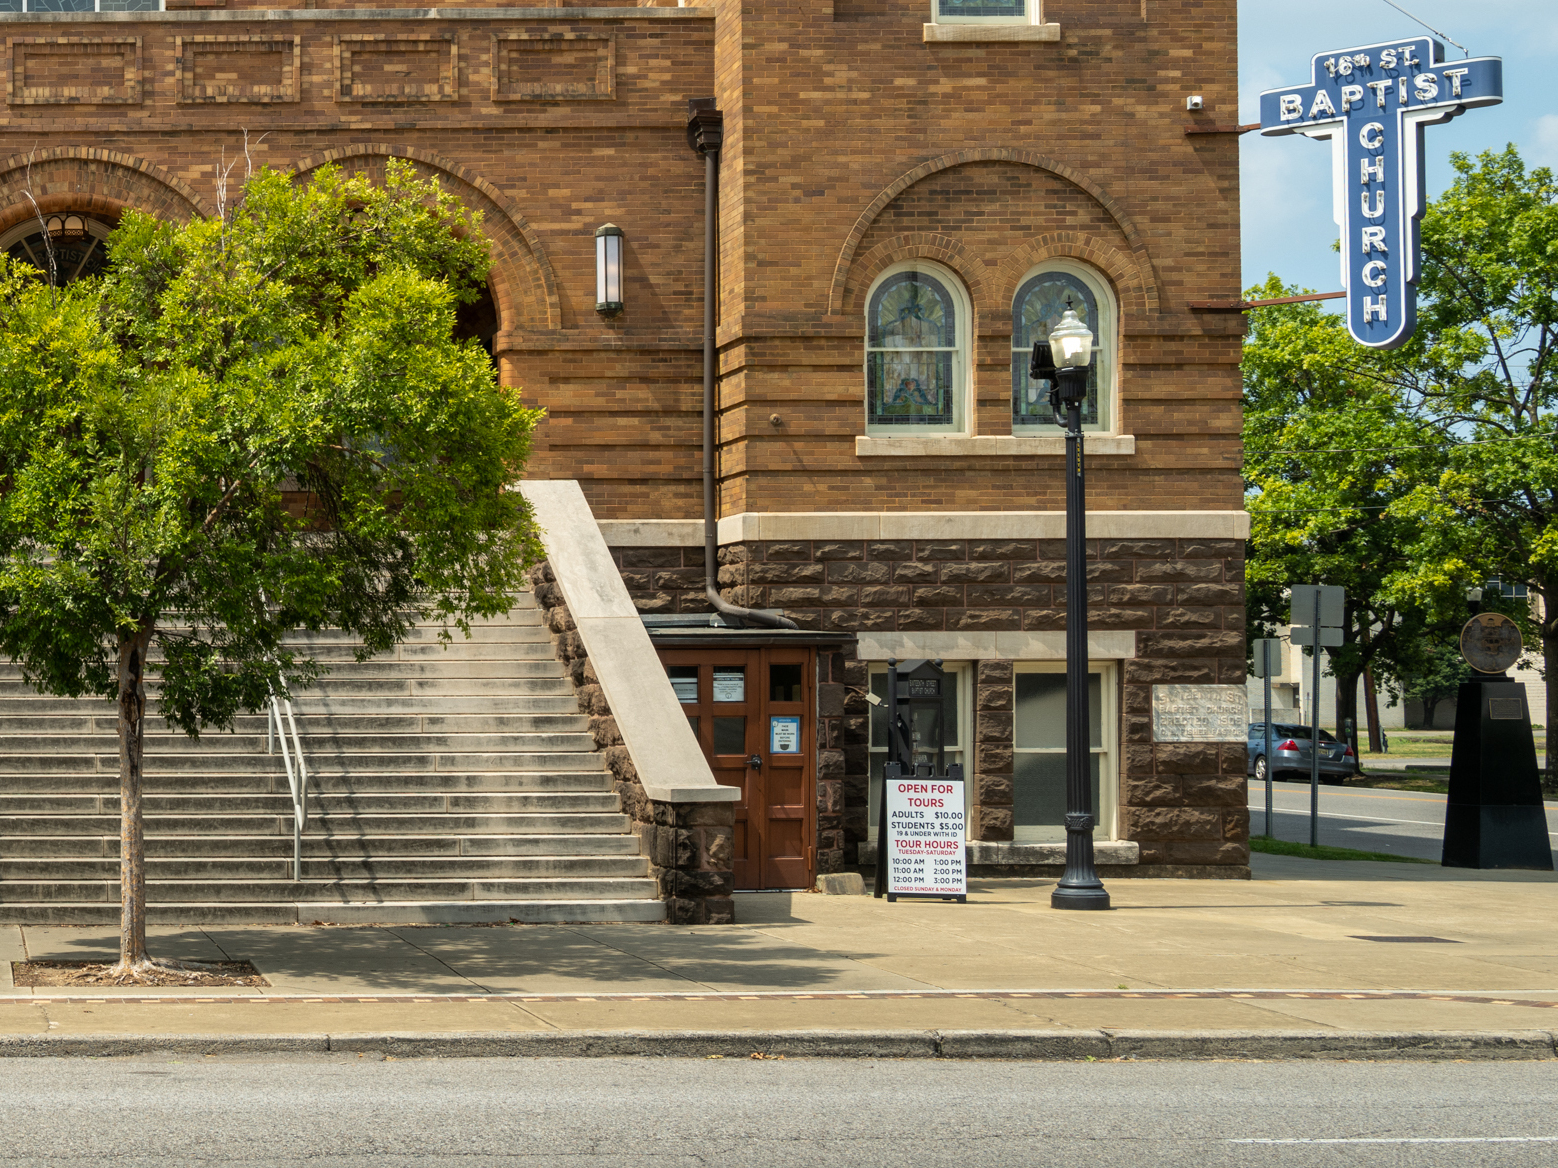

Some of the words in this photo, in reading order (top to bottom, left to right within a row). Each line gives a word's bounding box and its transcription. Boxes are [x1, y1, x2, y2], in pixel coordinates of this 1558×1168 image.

[1279, 67, 1469, 121] BAPTIST
[1359, 122, 1388, 323] CHURCH
[1159, 704, 1199, 713] BAPTIST
[1206, 705, 1242, 713] CHURCH
[1160, 715, 1209, 725] ERECTED
[897, 783, 928, 794] OPEN
[931, 784, 953, 794] FOR
[907, 797, 944, 808] TOURS
[891, 811, 925, 819] ADULTS
[934, 811, 963, 820] $10.00
[891, 821, 935, 830] STUDENTS
[939, 822, 963, 831] $5.00
[894, 839, 922, 849] TOUR
[924, 840, 959, 850] HOURS
